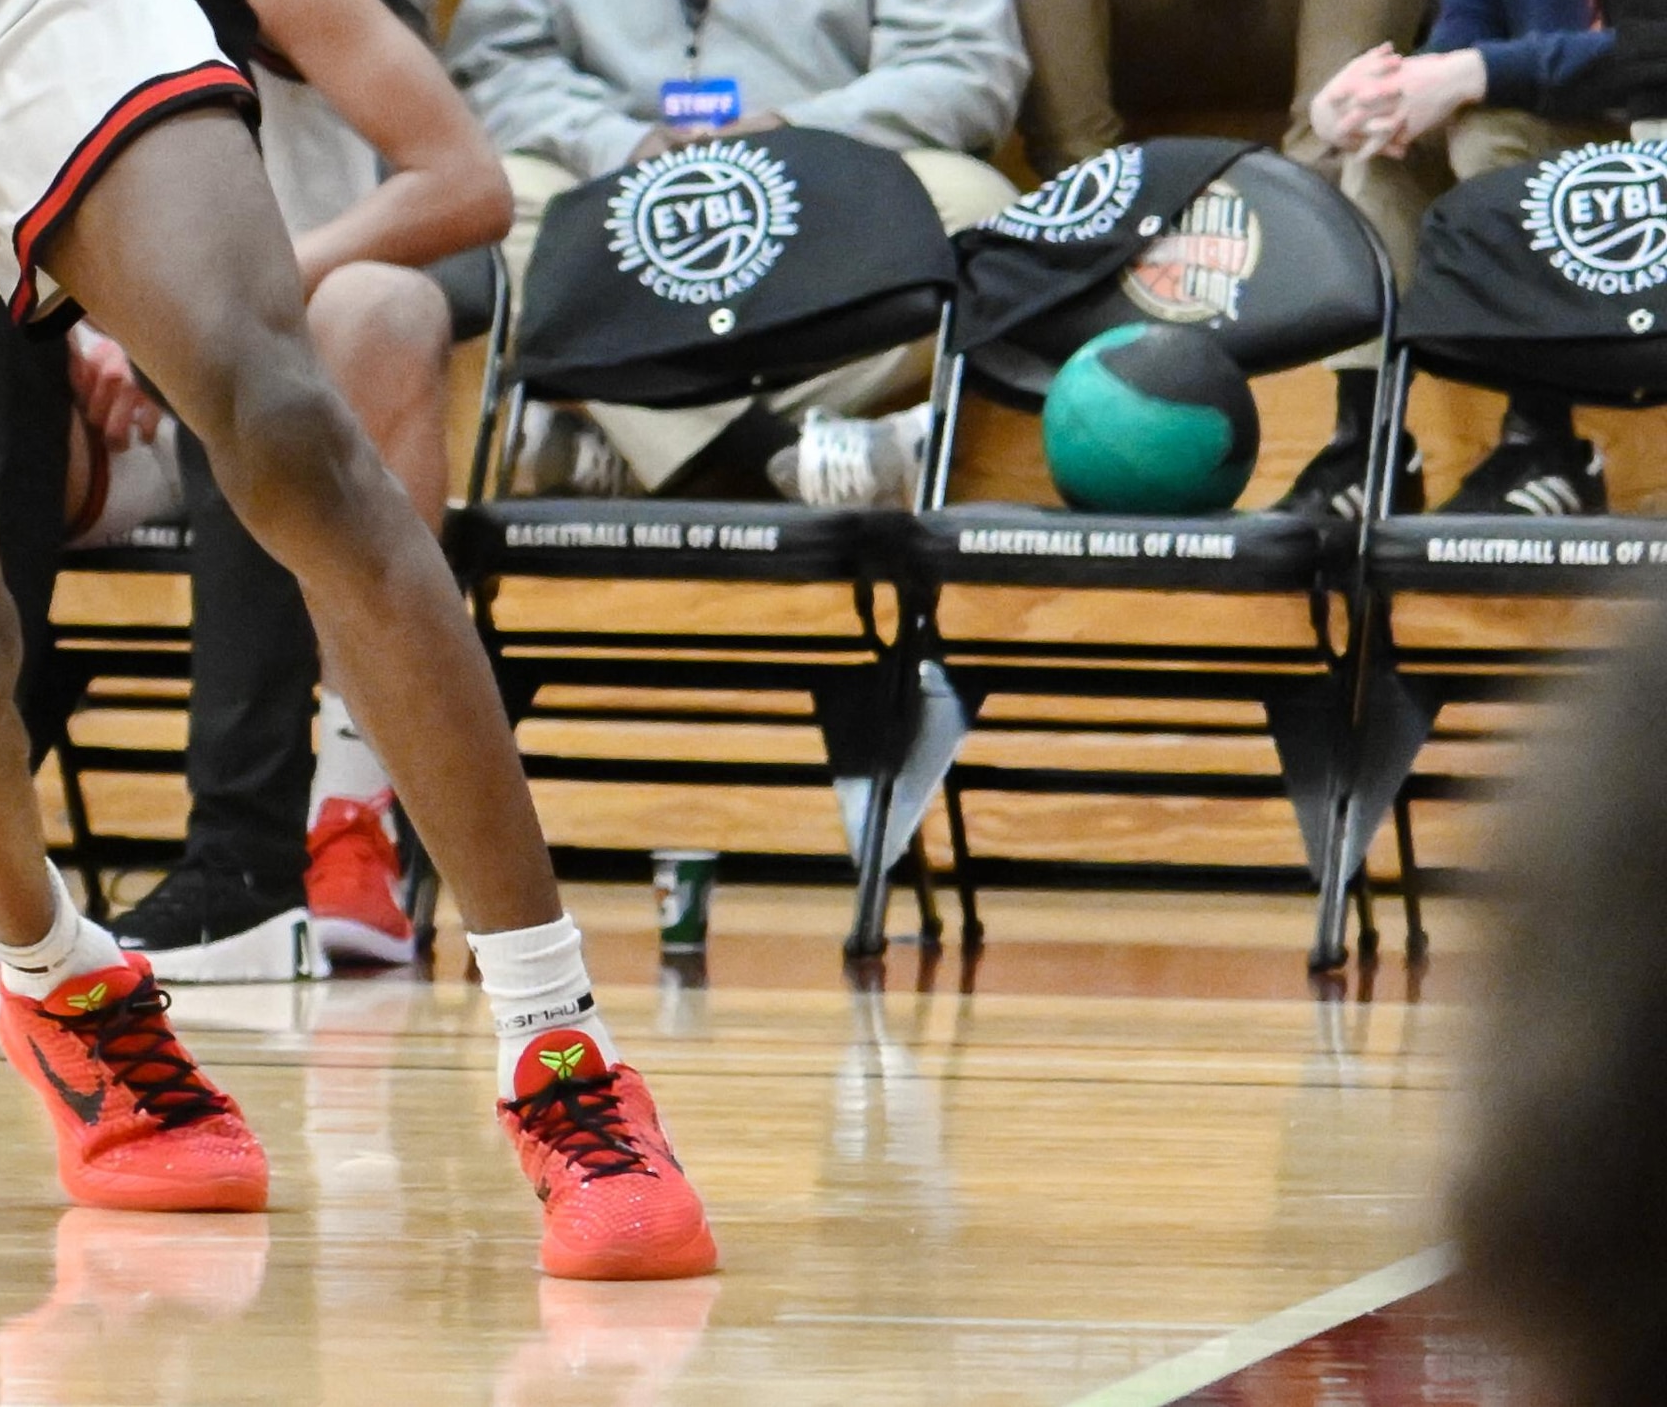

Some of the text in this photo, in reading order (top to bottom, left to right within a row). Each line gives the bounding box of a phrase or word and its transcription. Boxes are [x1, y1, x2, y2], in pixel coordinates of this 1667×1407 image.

[664, 95, 734, 116] STAFF
[652, 190, 753, 240] EYBL
[1569, 181, 1667, 225] EYBL
[638, 236, 786, 304] SCHOLASTIC
[1549, 249, 1667, 295] SCHOLAS
[505, 523, 779, 551] BASKETBALL HALL OF FAME
[959, 529, 1236, 559] BASKETBALL HALL OF FAME
[1427, 537, 1555, 563] BASKETBALL
[1559, 540, 1611, 565] HALL
[1616, 541, 1644, 565] OF
